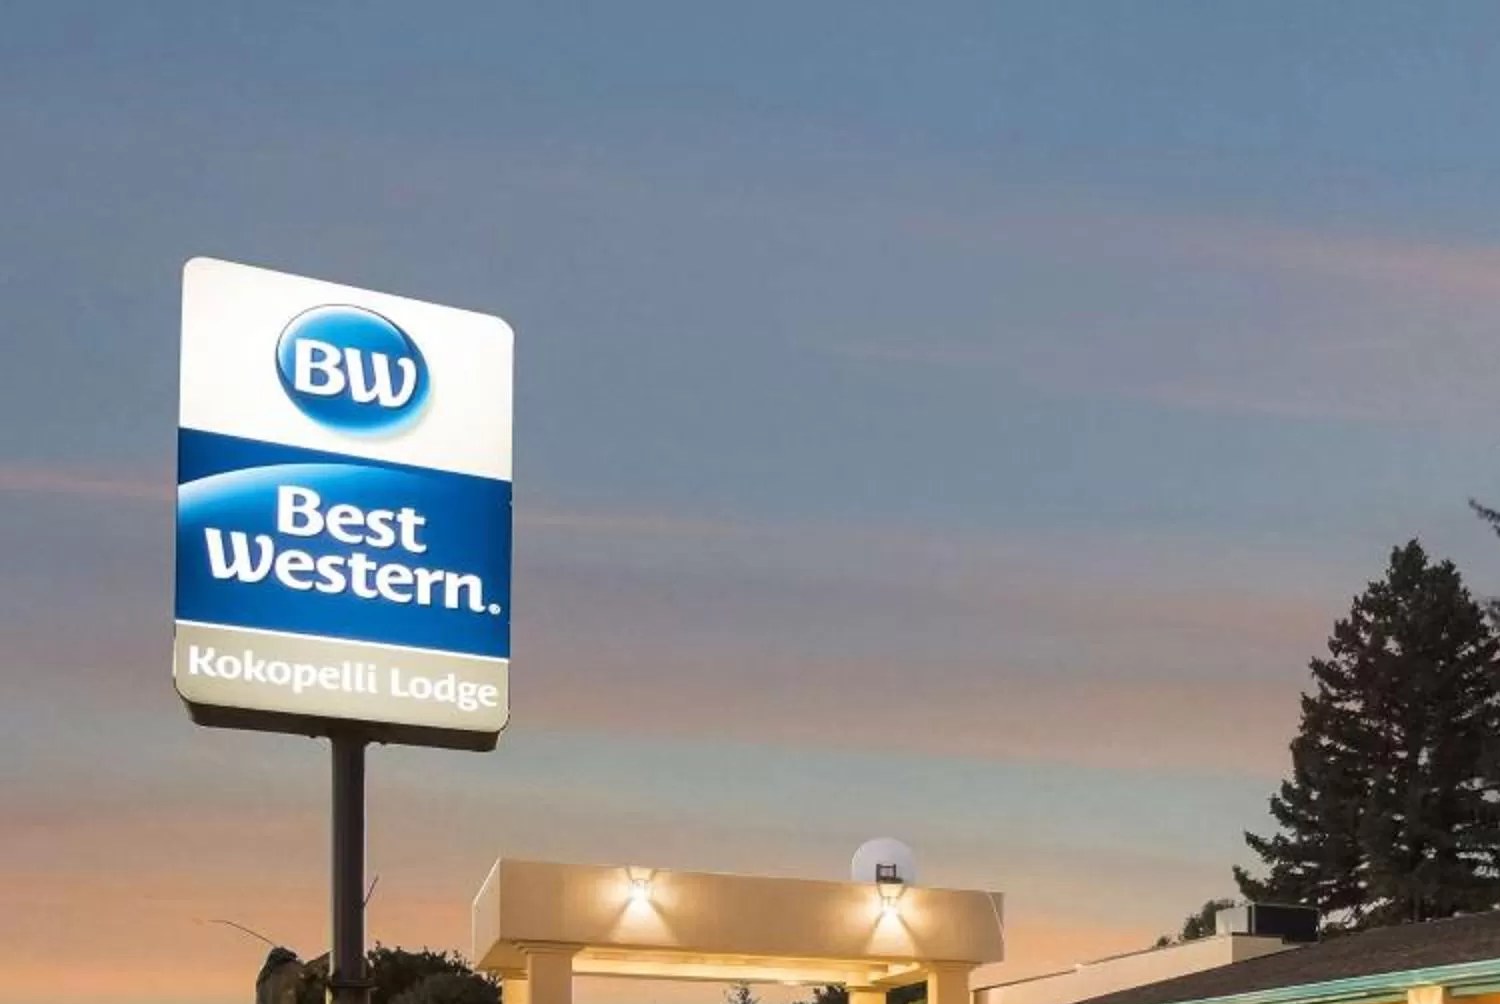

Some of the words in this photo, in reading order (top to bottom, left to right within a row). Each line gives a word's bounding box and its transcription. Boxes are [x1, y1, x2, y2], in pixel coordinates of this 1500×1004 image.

[294, 339, 417, 408] BW
[277, 484, 427, 553] Best
[188, 644, 378, 694] Kokopelli
[391, 669, 499, 712] Lodge
